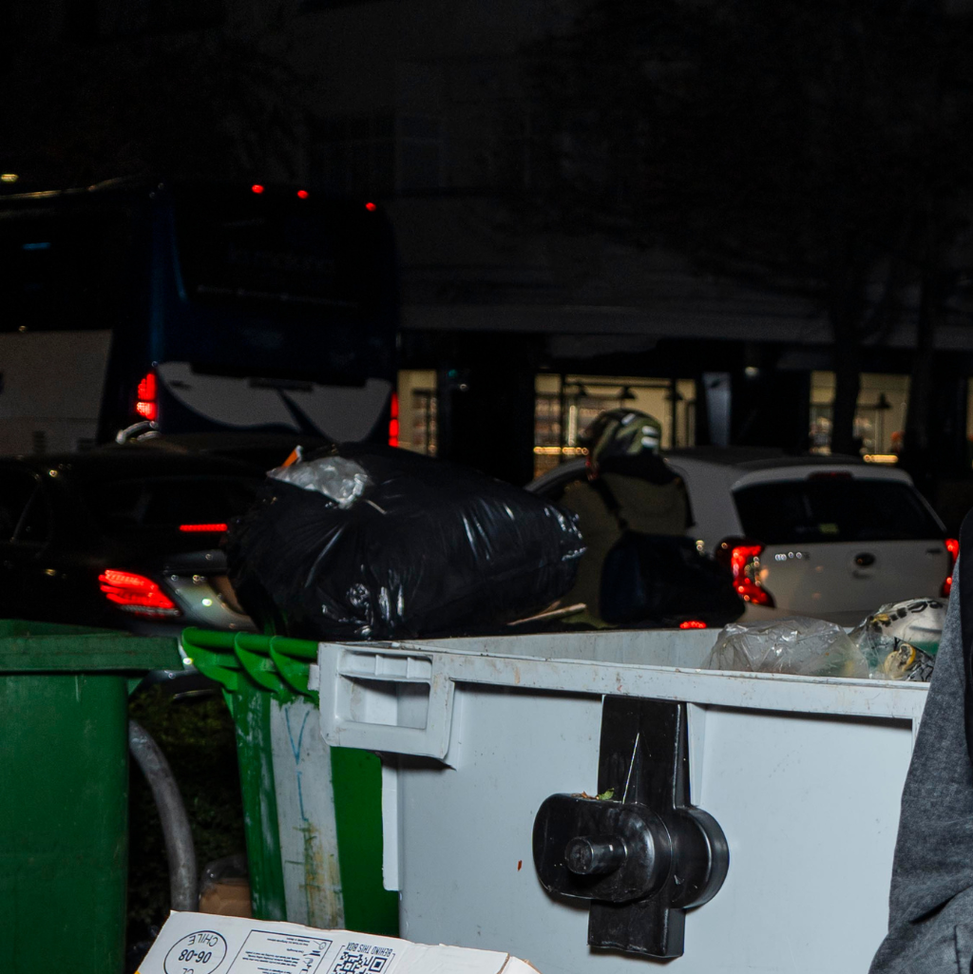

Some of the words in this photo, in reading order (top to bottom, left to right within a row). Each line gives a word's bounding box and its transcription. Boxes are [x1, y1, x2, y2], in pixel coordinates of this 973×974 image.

[187, 933, 219, 947] CHILE
[345, 942, 359, 952] BOX
[357, 943, 372, 954] THIS
[371, 946, 393, 957] BEHIND
[178, 948, 212, 964] 06-08
